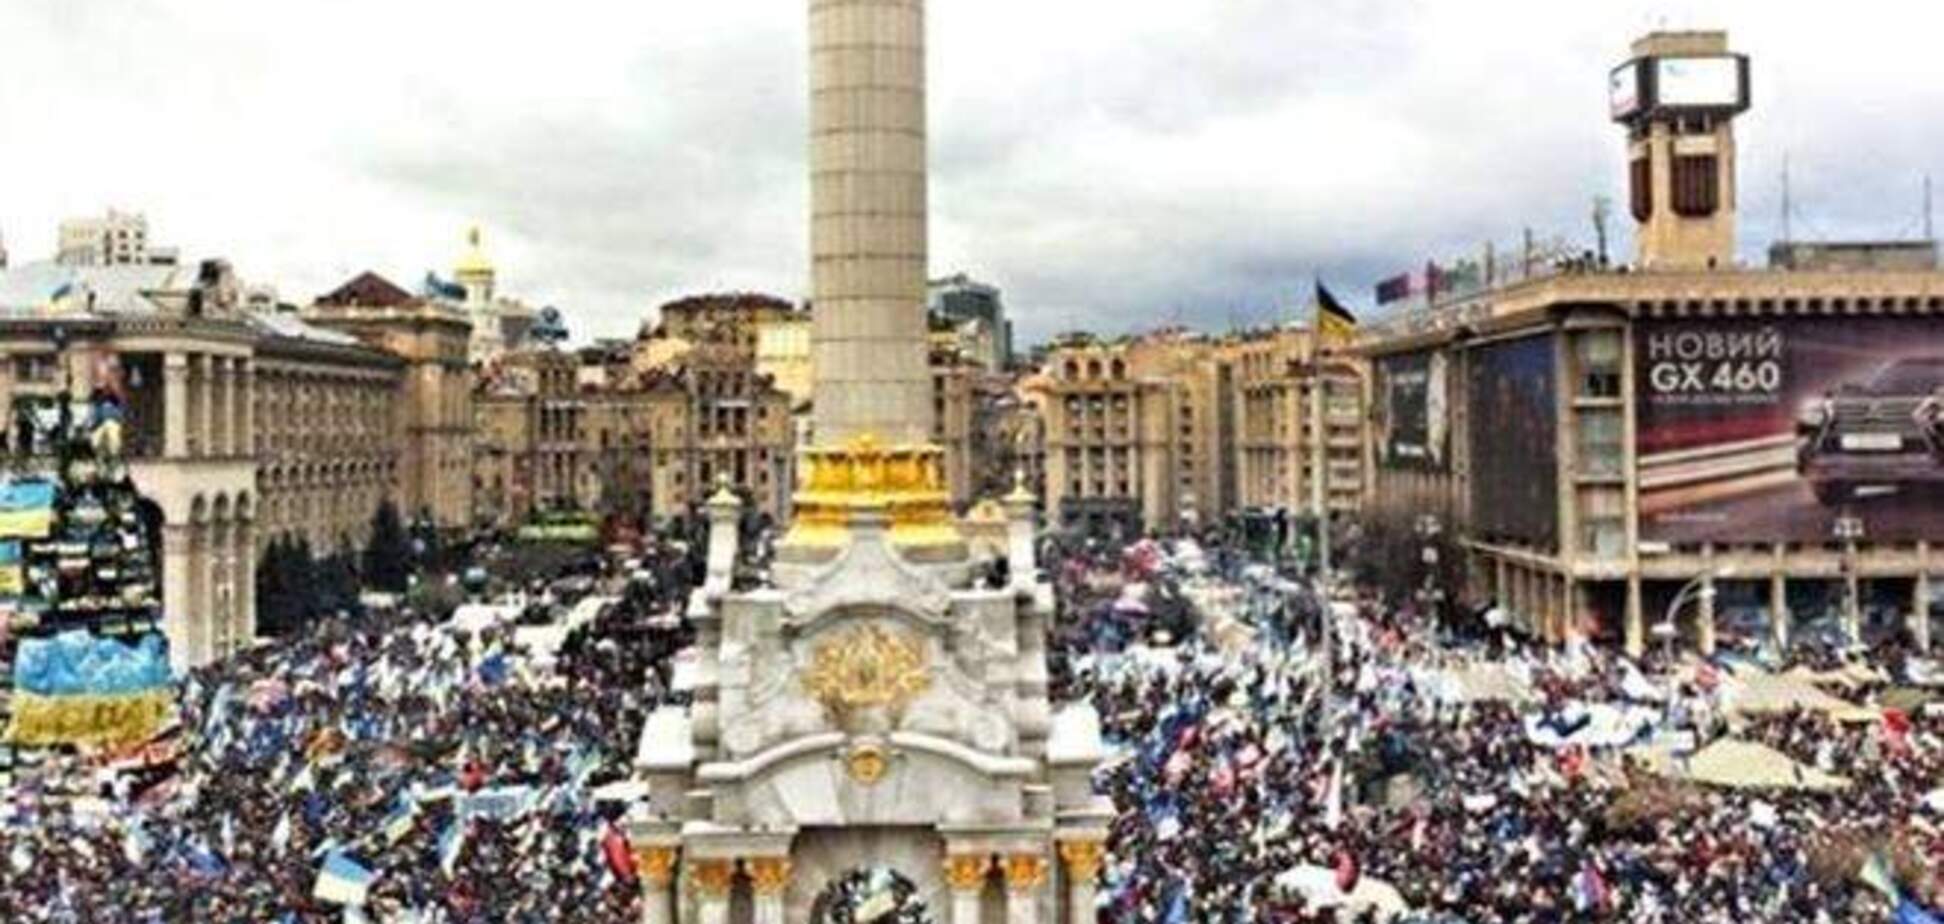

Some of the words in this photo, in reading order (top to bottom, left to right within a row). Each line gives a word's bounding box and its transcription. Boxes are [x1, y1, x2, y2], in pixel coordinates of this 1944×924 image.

[1649, 326, 1779, 359] НОВИЙ
[1650, 361, 1703, 392] GX
[1711, 361, 1779, 391] 460
